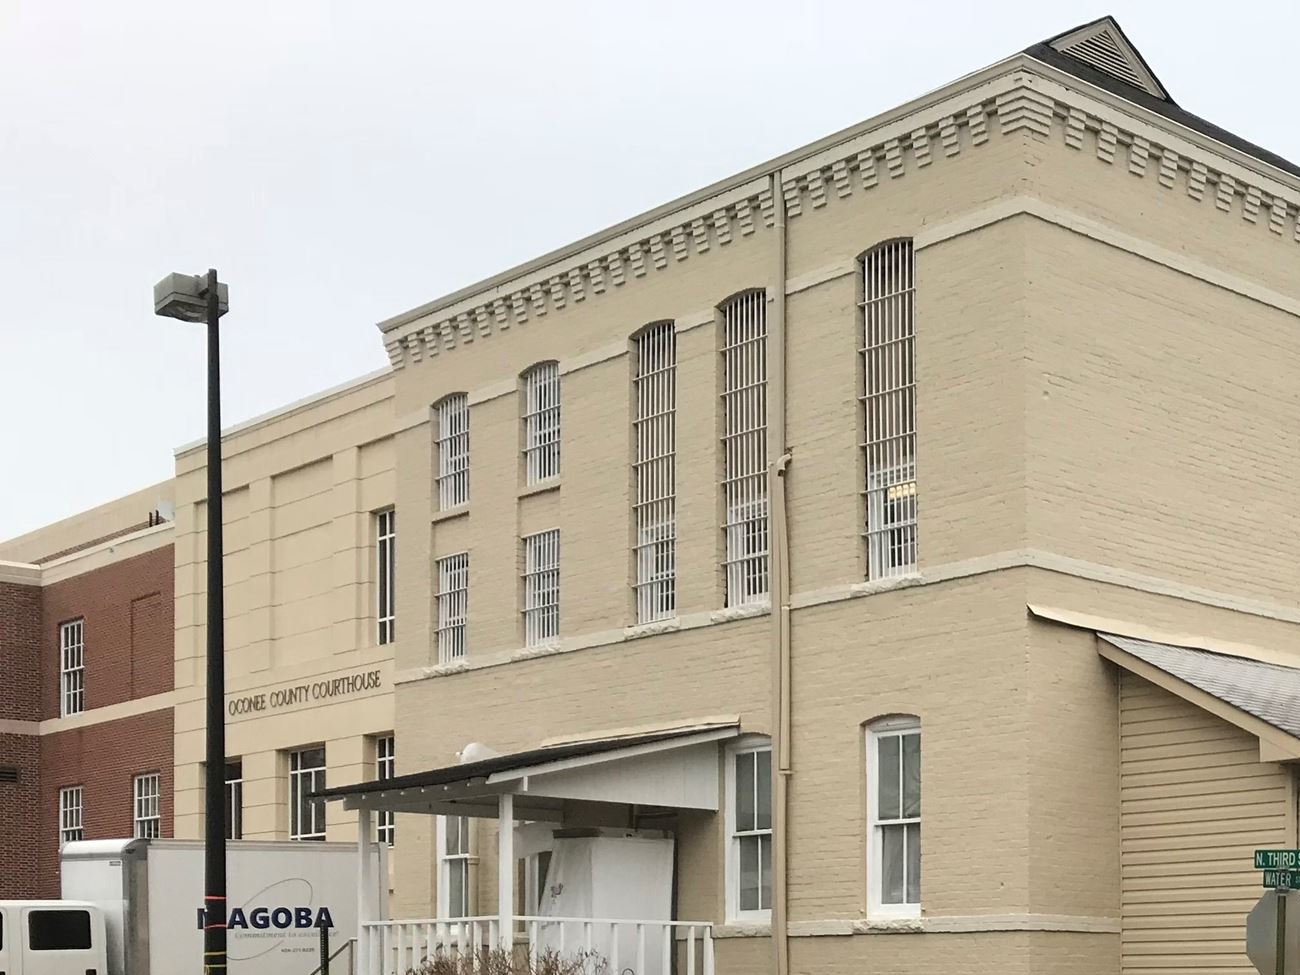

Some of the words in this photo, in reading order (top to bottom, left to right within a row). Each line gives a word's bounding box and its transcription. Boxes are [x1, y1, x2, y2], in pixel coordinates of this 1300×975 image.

[228, 694, 266, 716] OCONEE
[270, 684, 310, 708] COUNTY
[312, 670, 382, 700] COURTHOUSE
[1256, 852, 1265, 866] N.
[1267, 852, 1296, 866] THIRD
[1264, 872, 1291, 887] WATER
